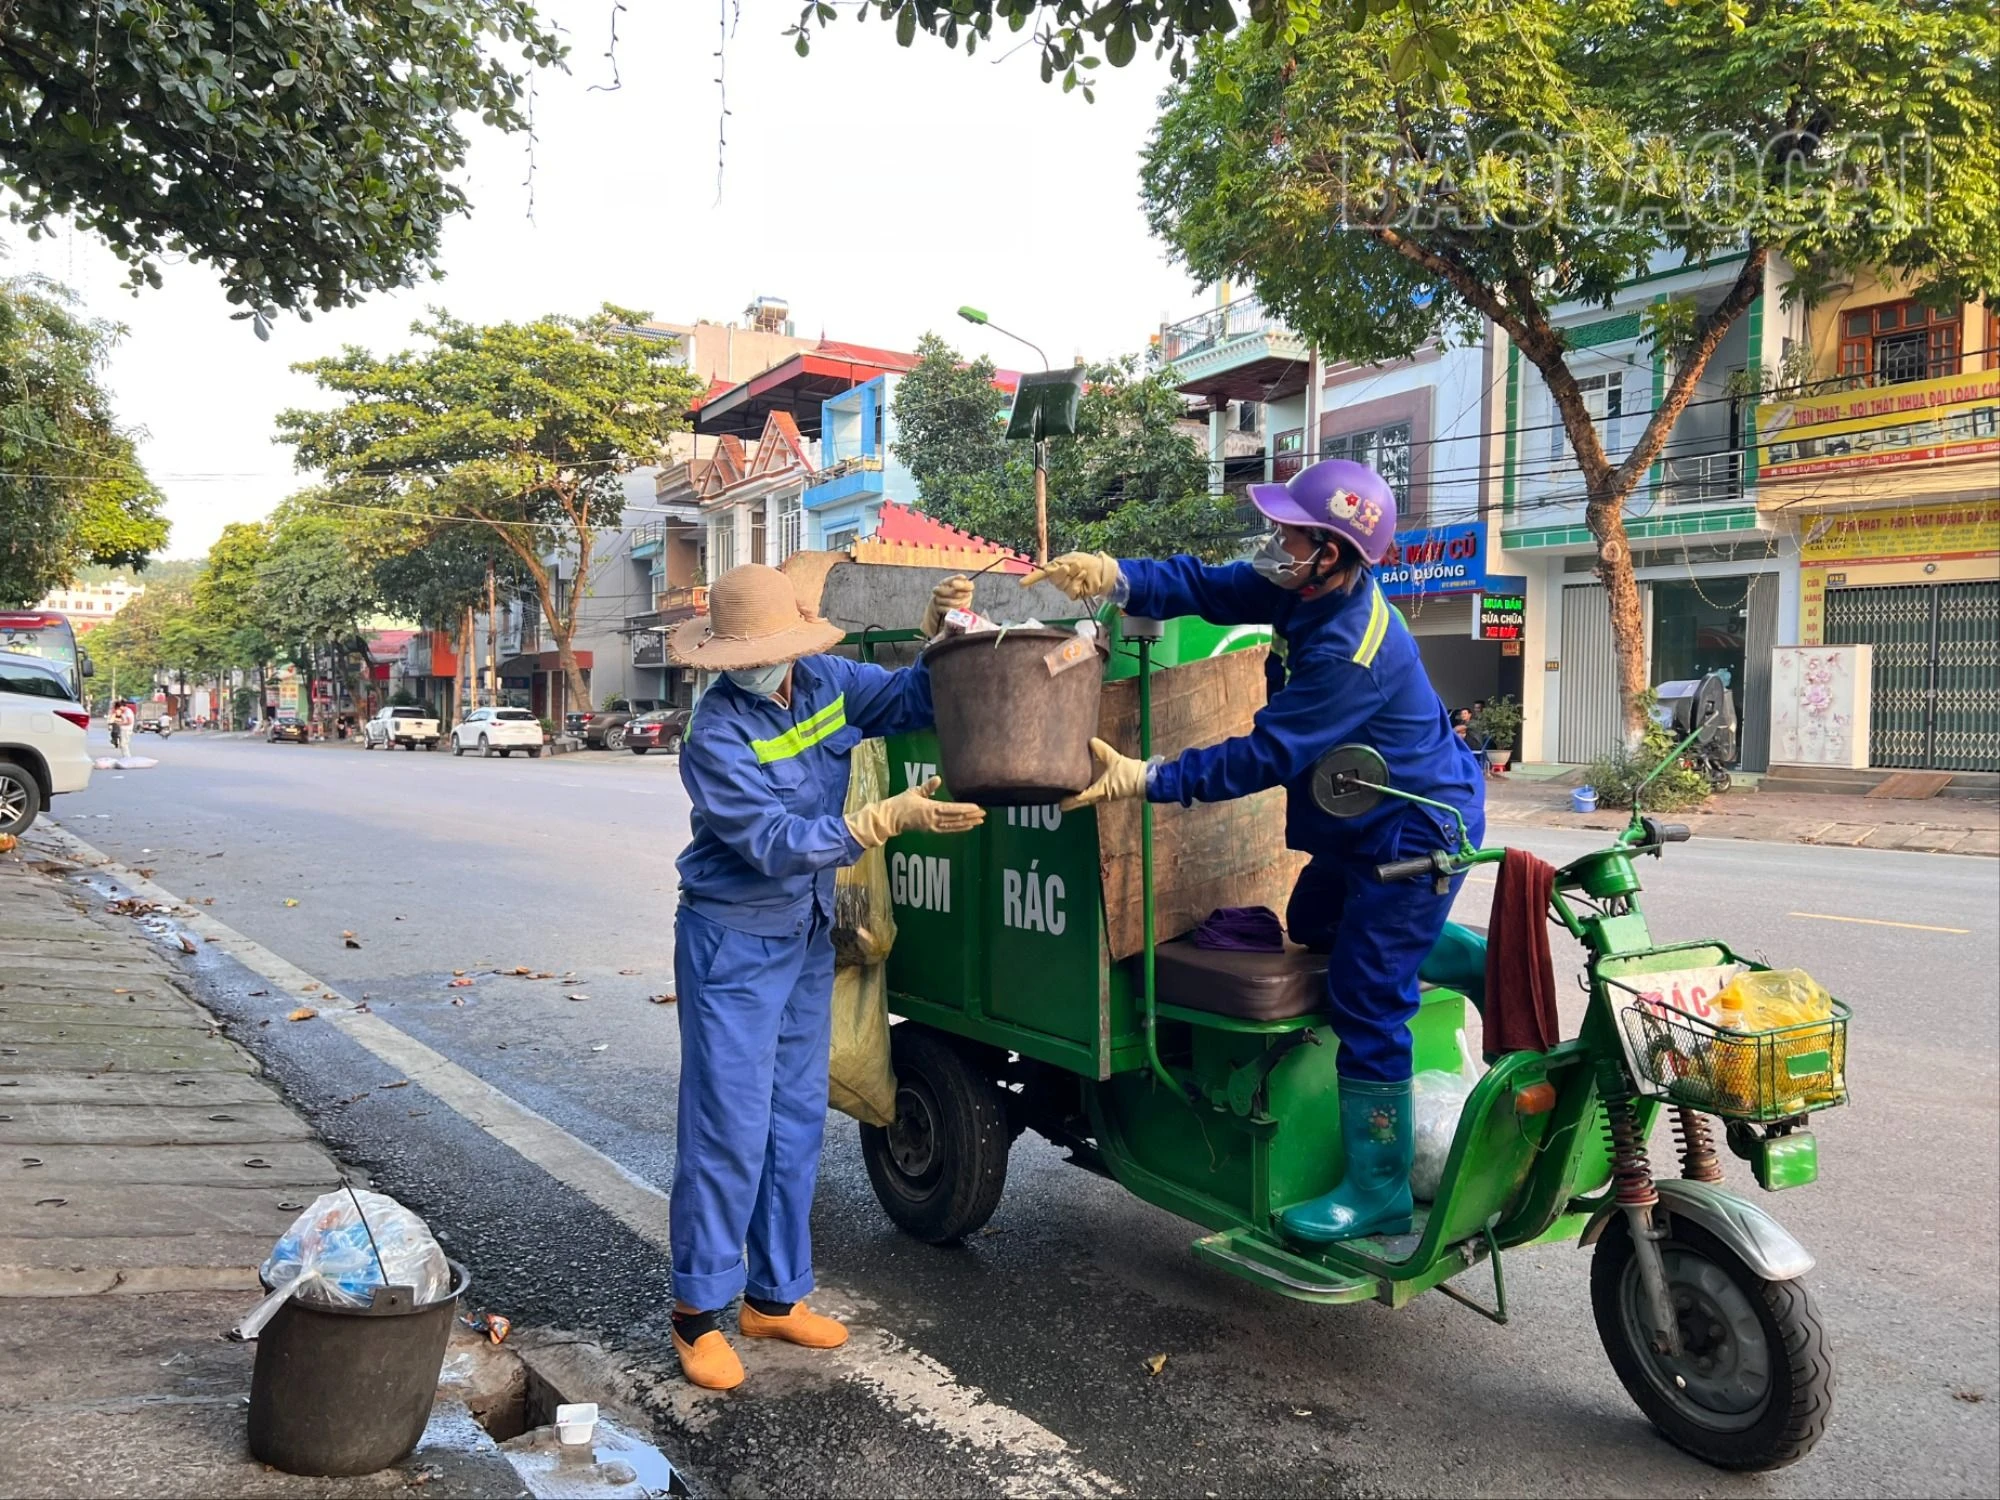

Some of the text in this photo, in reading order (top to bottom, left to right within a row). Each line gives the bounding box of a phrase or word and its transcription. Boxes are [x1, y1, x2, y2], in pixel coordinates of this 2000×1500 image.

[1449, 531, 1476, 560] CŨ
[1382, 567, 1409, 583] BẢO
[1483, 598, 1503, 609] MUA
[1481, 611, 1523, 624] SỬA CHỮA
[1486, 626, 1498, 638] XE
[891, 851, 950, 913] GOM
[1003, 859, 1066, 935] RÁC
